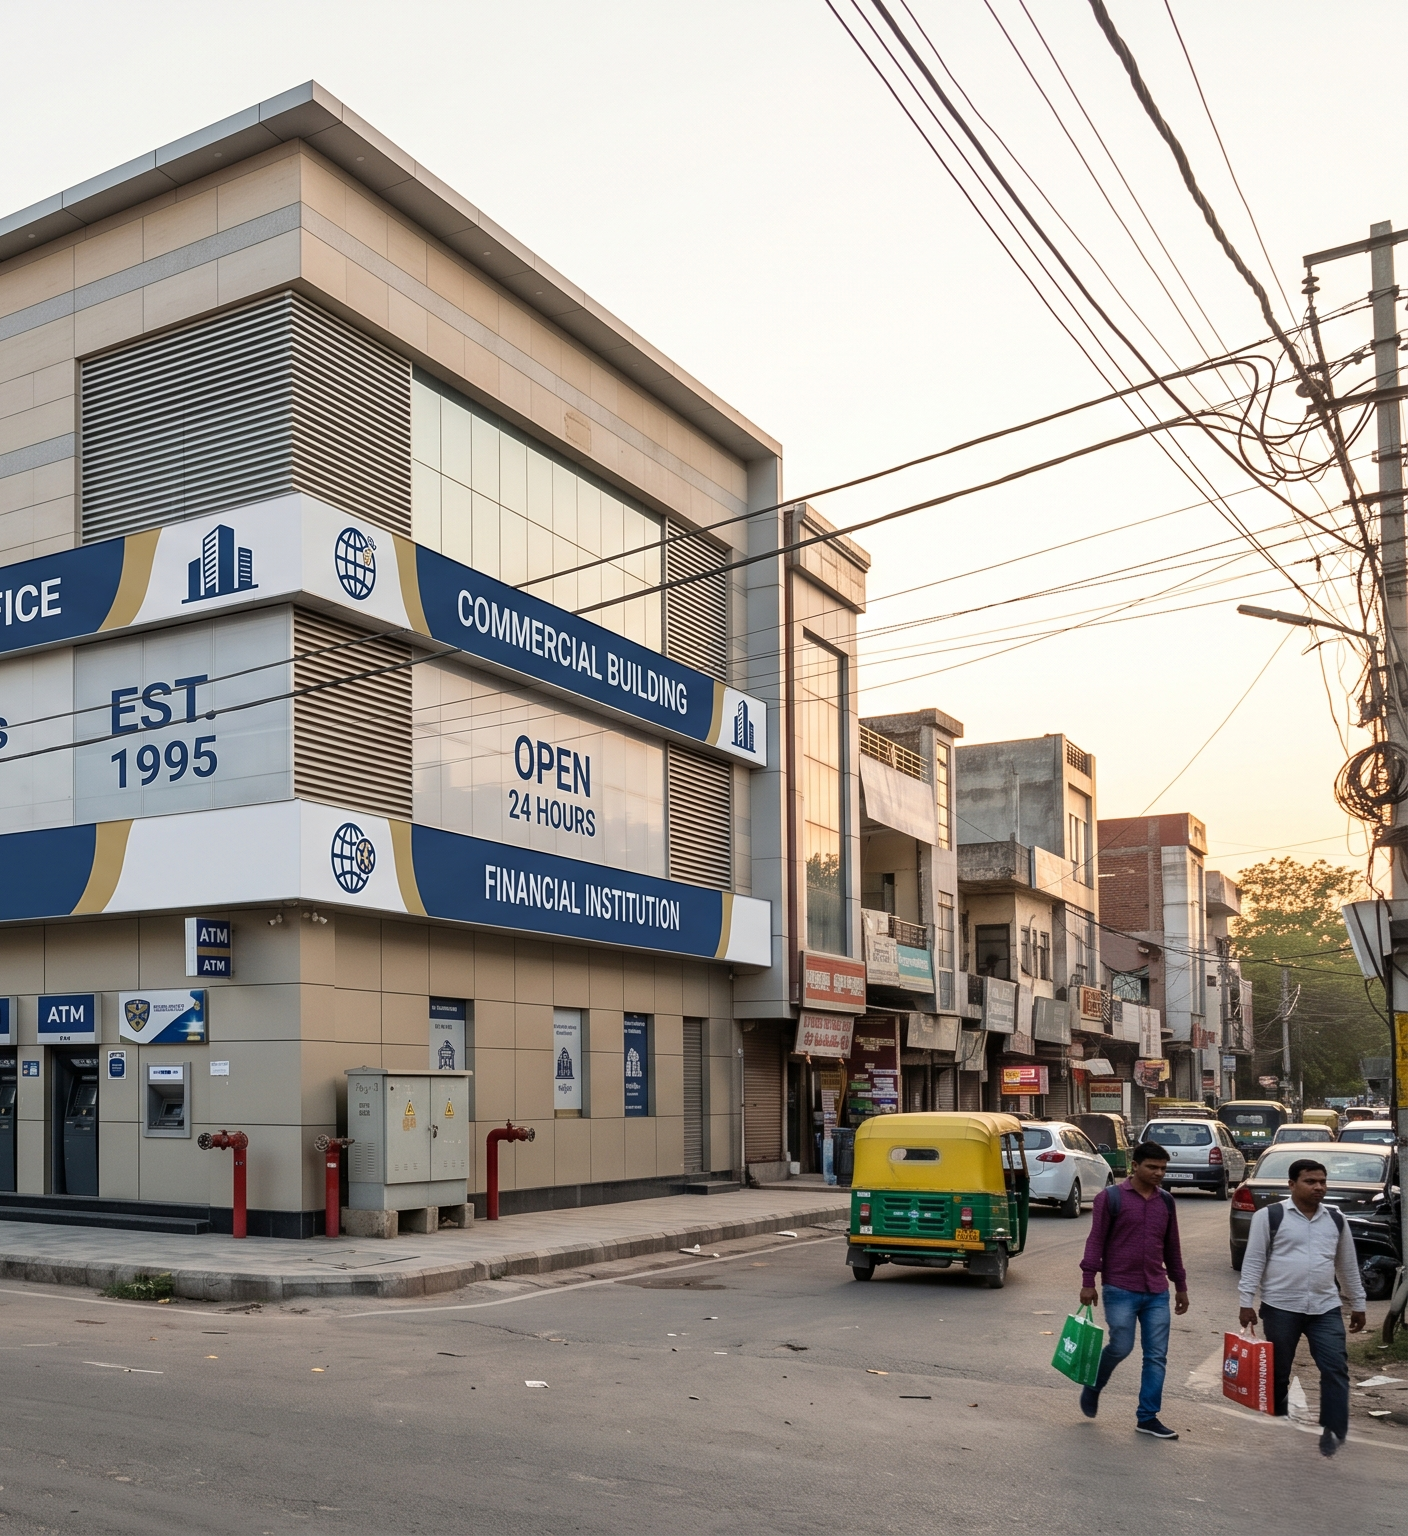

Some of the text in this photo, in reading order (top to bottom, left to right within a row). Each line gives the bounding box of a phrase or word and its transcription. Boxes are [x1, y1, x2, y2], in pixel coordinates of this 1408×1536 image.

[457, 589, 688, 716] COMMERCIAL BUILDING
[110, 674, 217, 735] EST.
[110, 735, 219, 790] 1995
[514, 734, 591, 798] OPEN
[508, 788, 597, 838] 24 HOURS
[485, 863, 680, 932] FINANCIAL INSTITUTION
[199, 927, 228, 944] ATM
[203, 959, 225, 971] ATM
[47, 1004, 85, 1023] ATM
